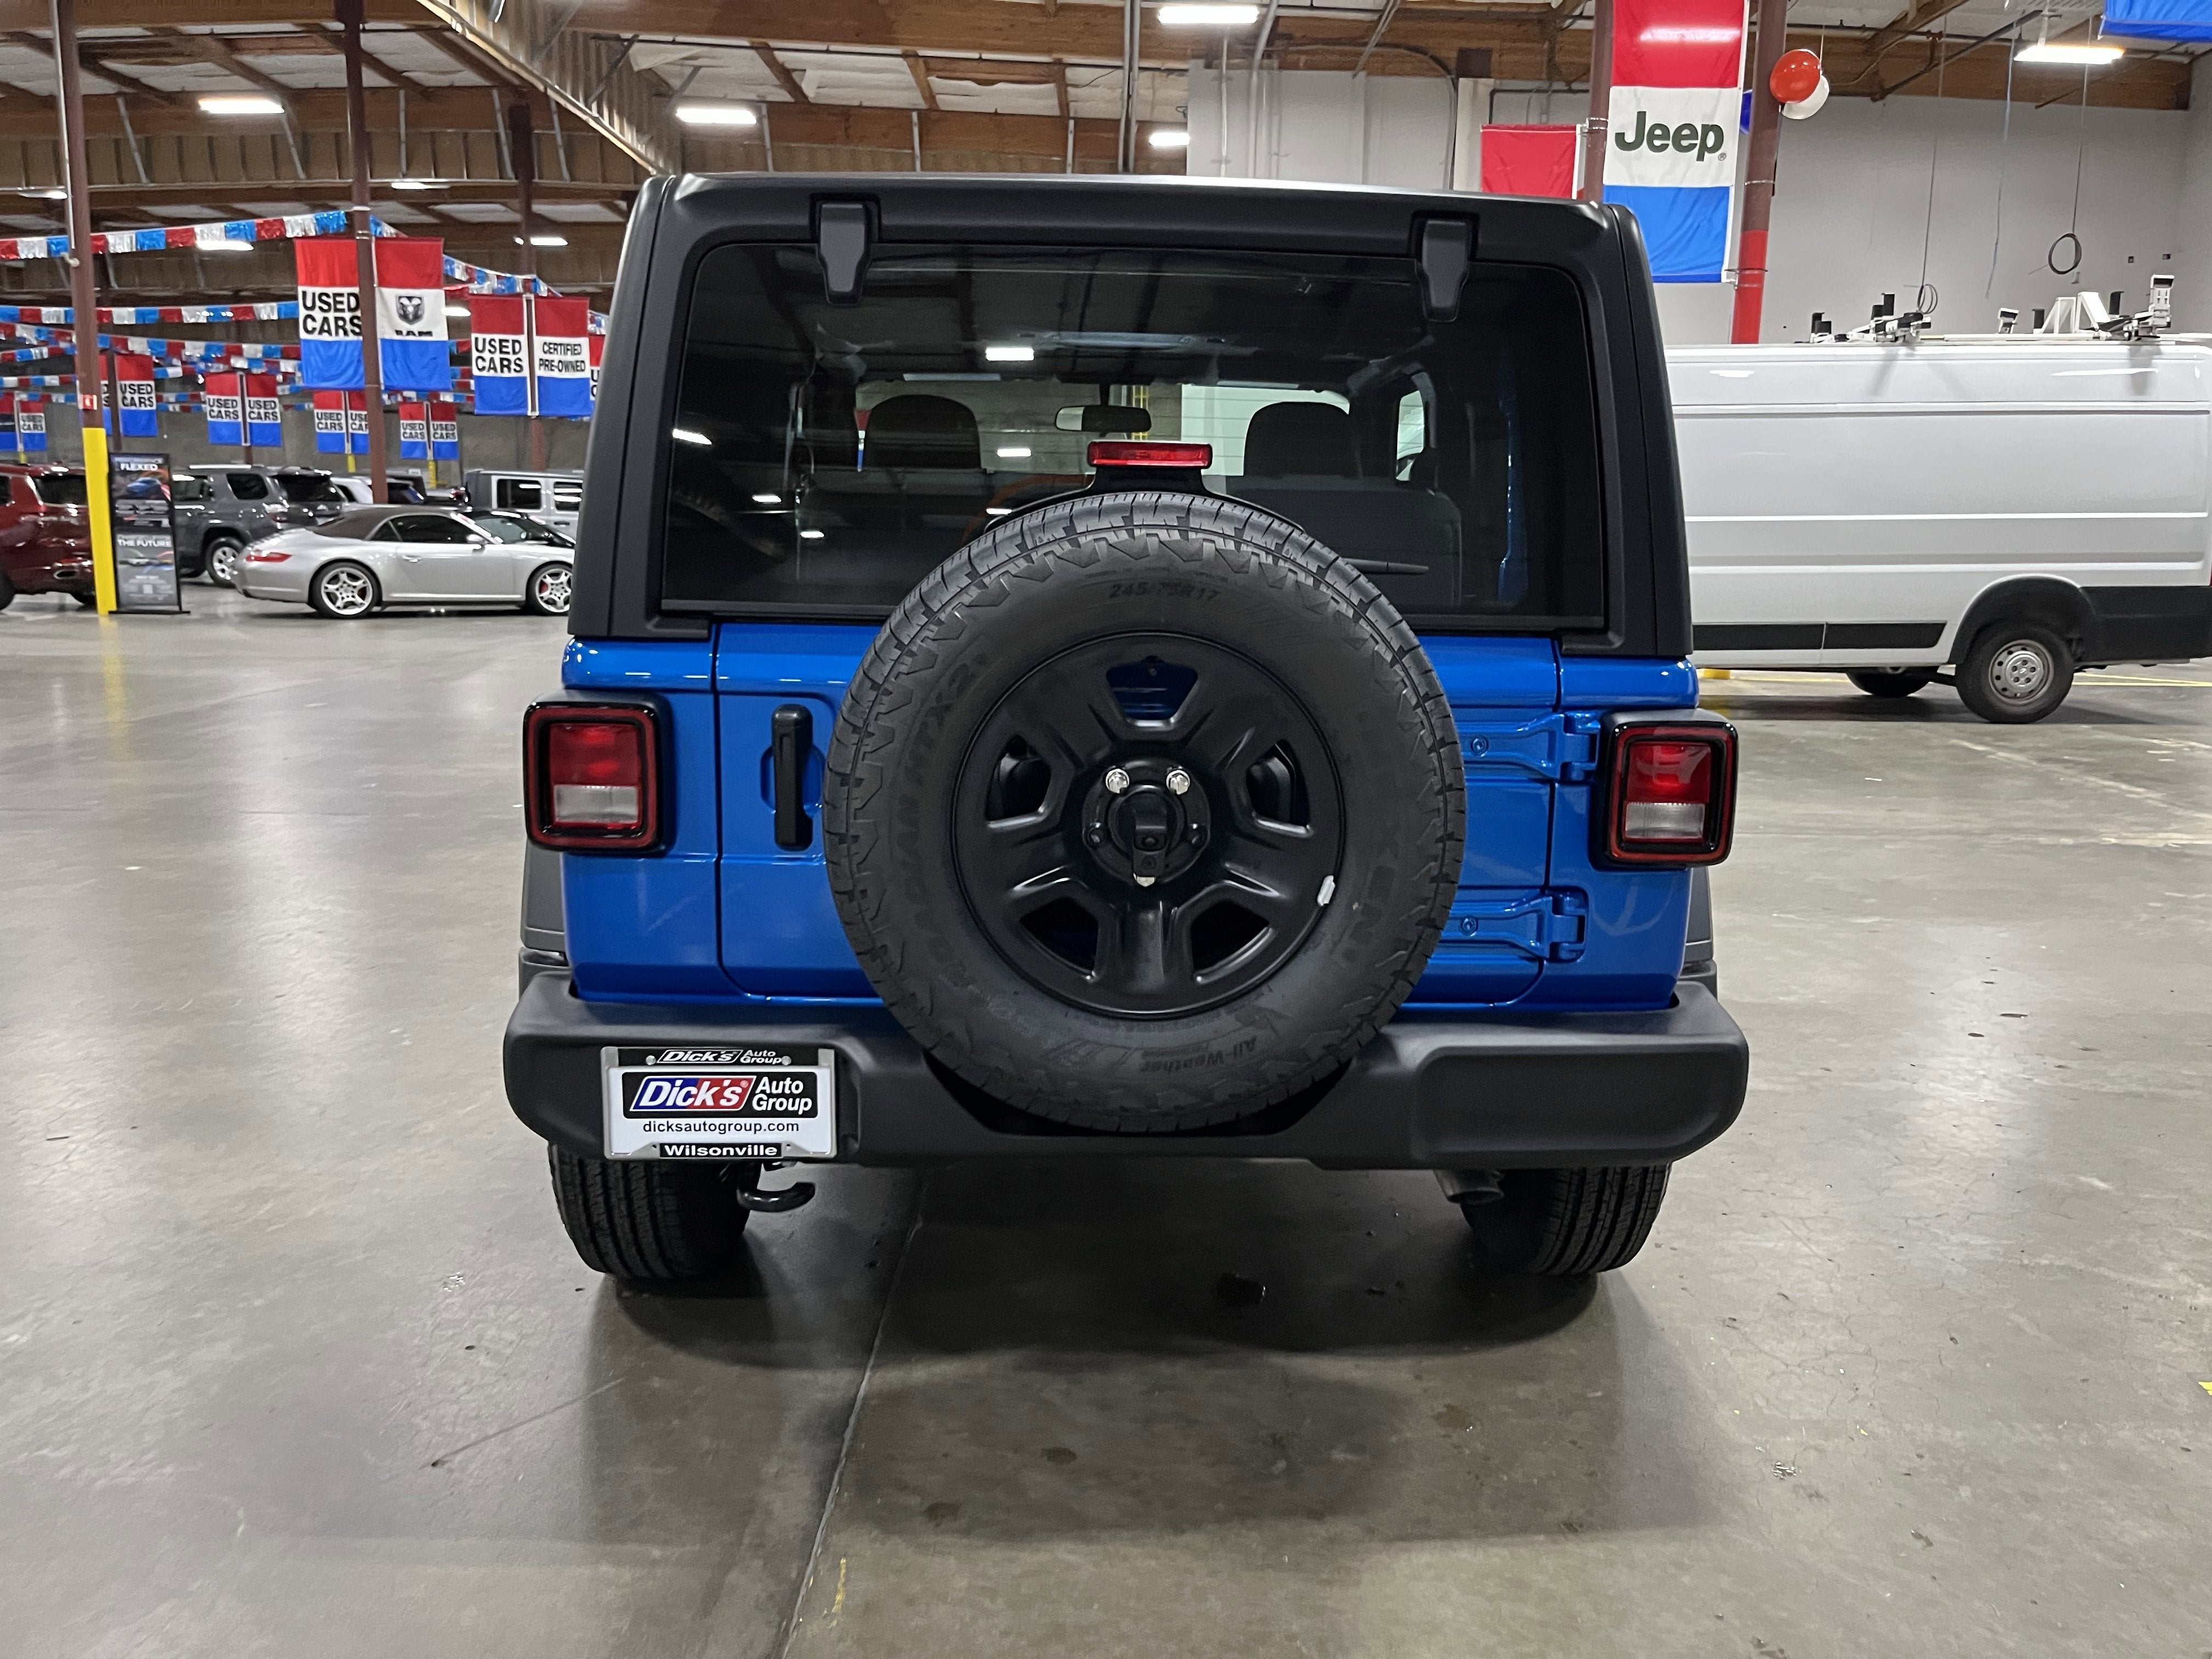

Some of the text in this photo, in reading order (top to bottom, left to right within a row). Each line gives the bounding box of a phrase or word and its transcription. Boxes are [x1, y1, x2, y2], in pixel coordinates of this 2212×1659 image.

[1615, 111, 1724, 161] Jeep
[302, 291, 360, 313] USED
[303, 314, 362, 336] CARS
[475, 337, 522, 356] USED
[543, 342, 582, 356] CERTIFIED
[475, 356, 523, 374] CARS
[539, 358, 585, 373] PRE-OWNED
[120, 383, 153, 395] USED
[122, 396, 154, 408] CARS
[208, 398, 238, 409] USED
[248, 399, 276, 410] USED
[208, 409, 239, 420] CARS
[248, 411, 278, 421] CARS
[317, 412, 342, 421] USED
[317, 422, 343, 431] CARS
[402, 422, 424, 430] USED
[432, 423, 455, 431] USED
[402, 431, 425, 439] CARS
[433, 432, 456, 440] CARS
[663, 1051, 733, 1061] Dick's
[740, 1056, 782, 1064] Group
[755, 1076, 804, 1094] Auto
[639, 1079, 742, 1106] Dick's
[752, 1094, 812, 1115] Group
[643, 1120, 799, 1135] dicksautogroup.com
[664, 1145, 777, 1156] Wilsonville
